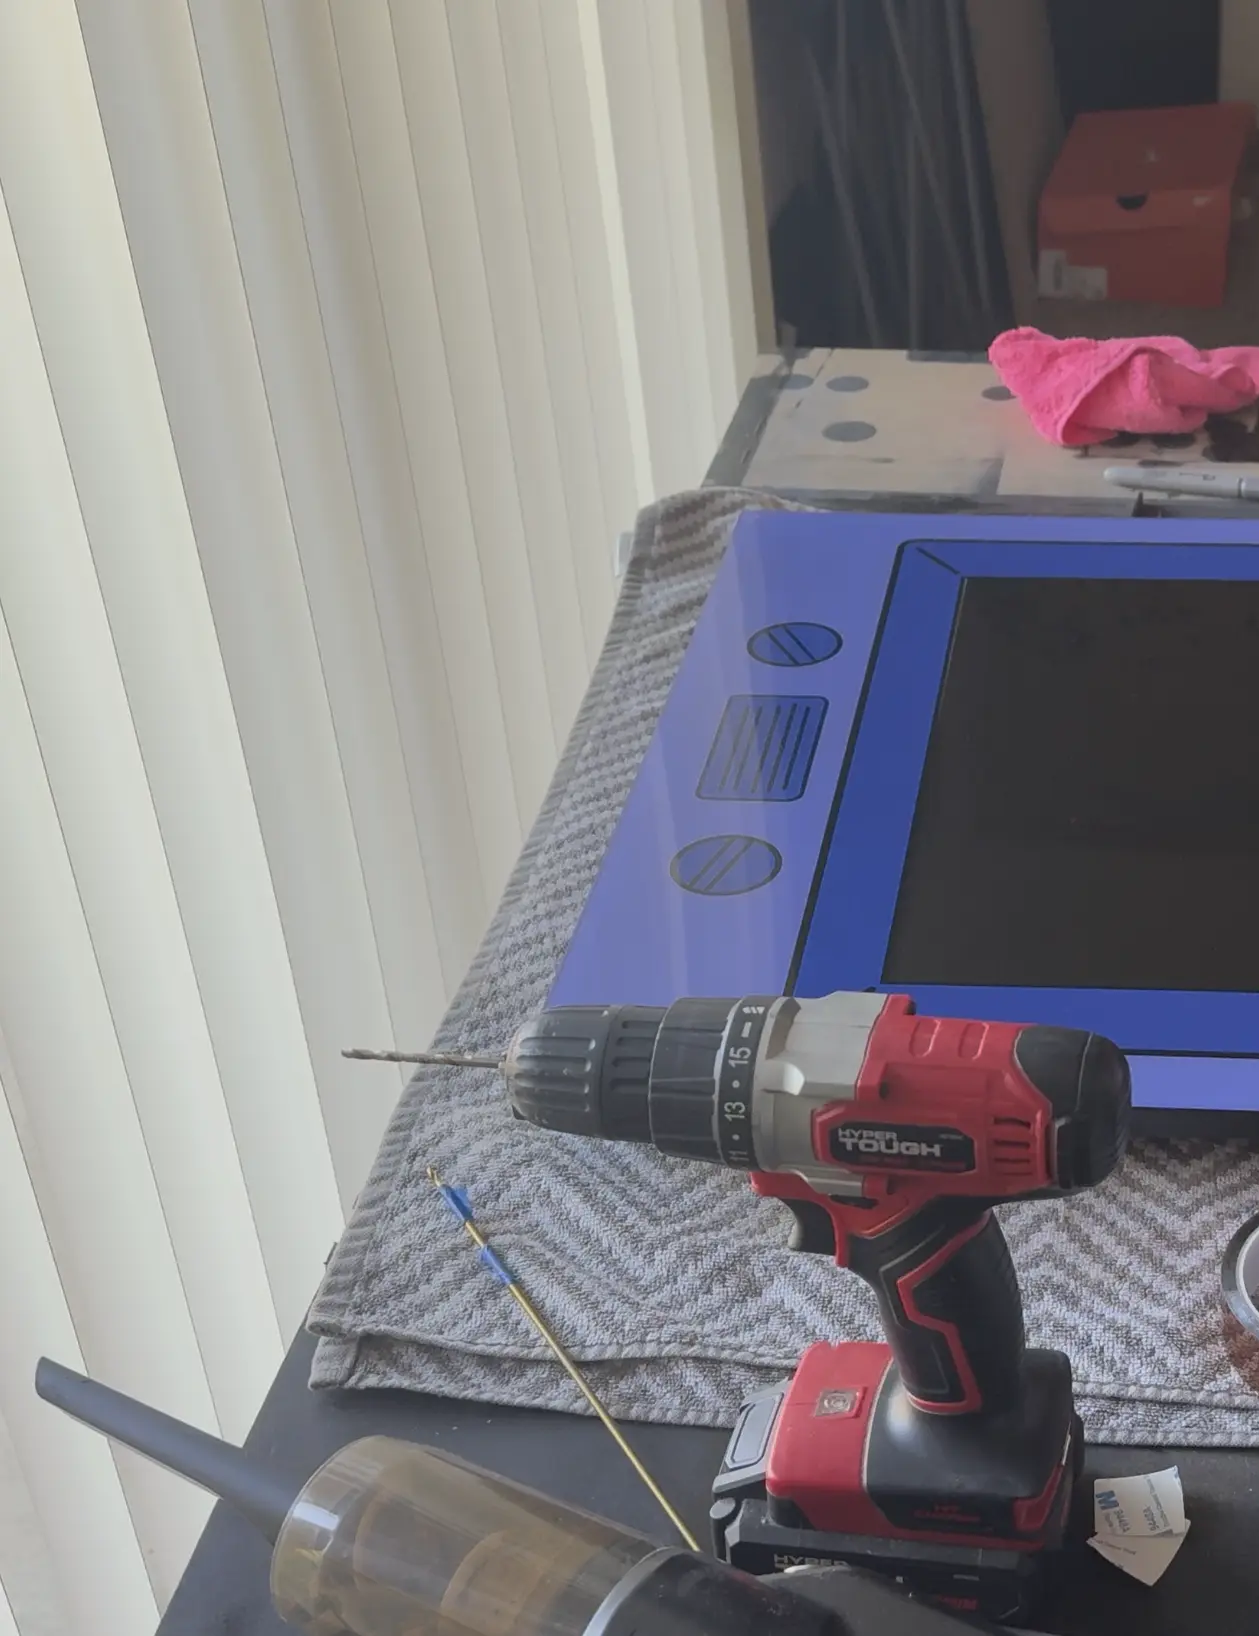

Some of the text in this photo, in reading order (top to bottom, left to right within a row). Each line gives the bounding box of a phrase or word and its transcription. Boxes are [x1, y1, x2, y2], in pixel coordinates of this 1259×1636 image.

[728, 1047, 751, 1069] 15
[724, 1101, 746, 1122] 13
[838, 1128, 898, 1140] HYPER
[729, 1151, 750, 1161] 11
[838, 1138, 942, 1157] TOUGH
